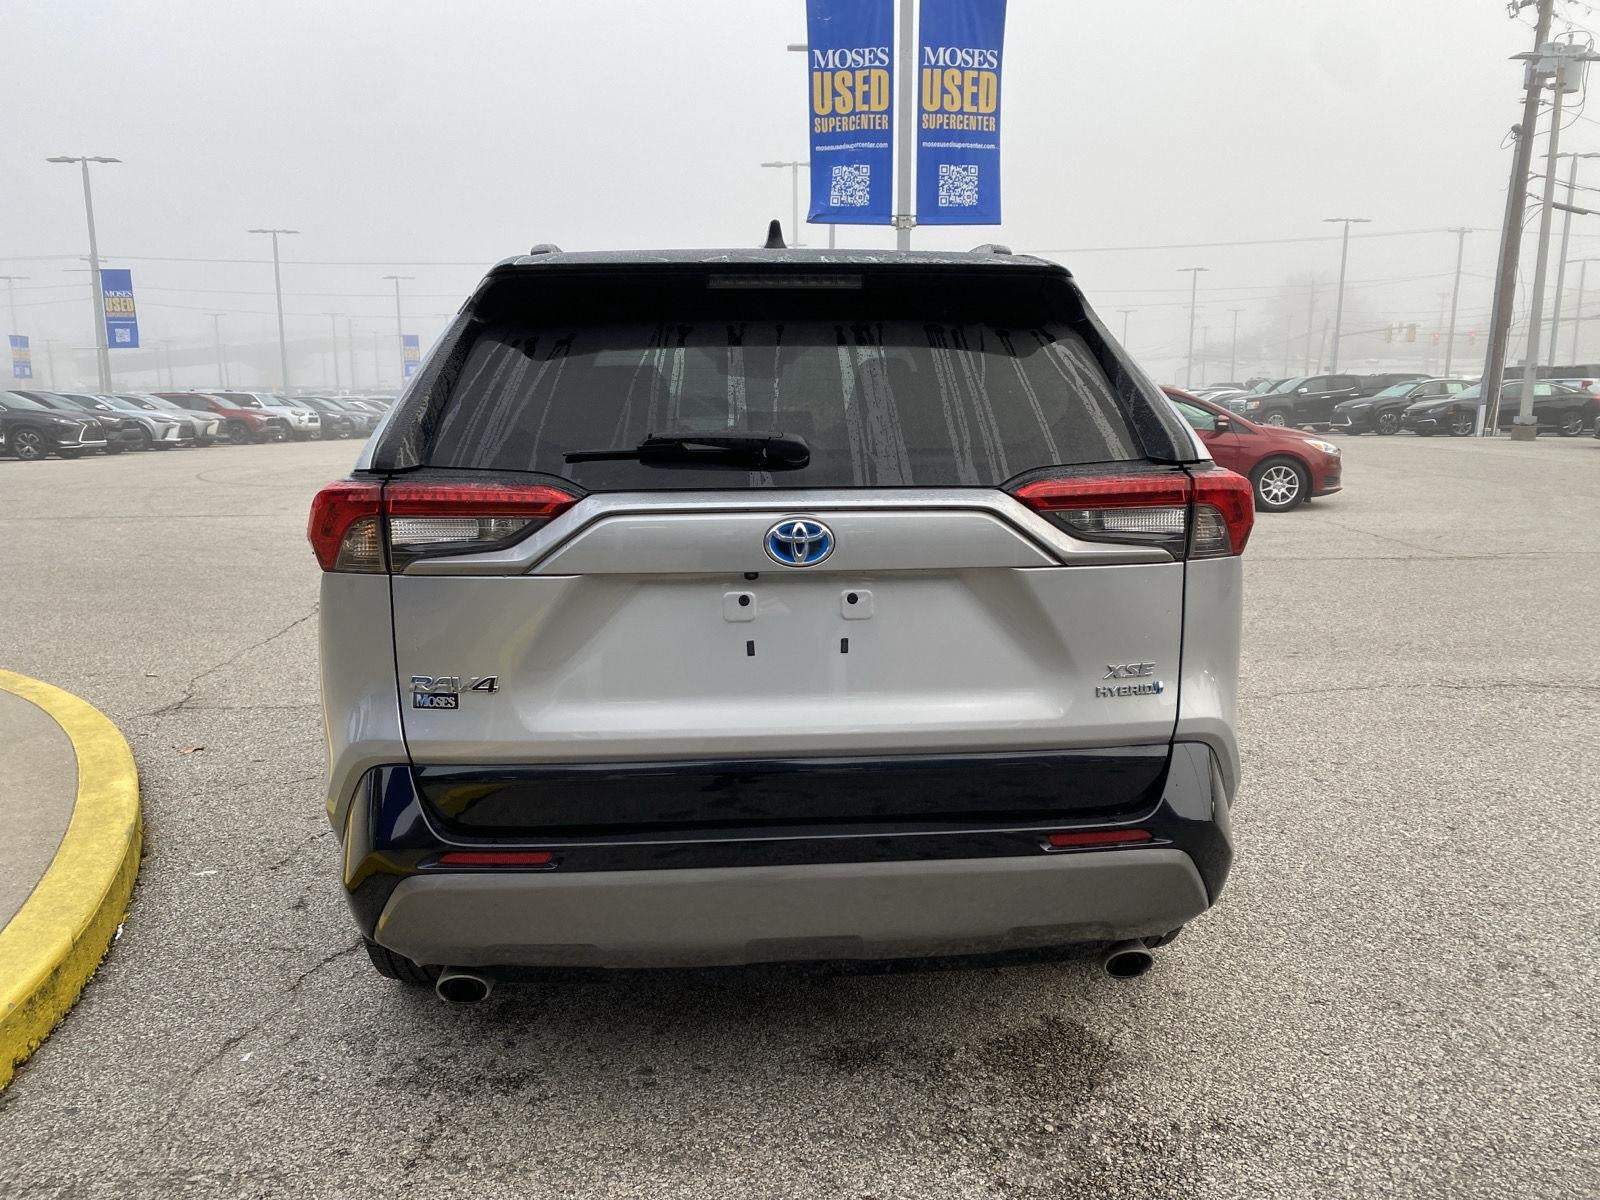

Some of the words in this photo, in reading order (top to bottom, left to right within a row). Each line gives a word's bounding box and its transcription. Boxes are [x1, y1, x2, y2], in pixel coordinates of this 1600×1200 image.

[812, 47, 889, 69] MOSES
[923, 47, 998, 68] MOSES
[812, 69, 889, 115] USED
[922, 68, 997, 113] USED
[814, 114, 889, 133] SUPERCENTER
[922, 113, 996, 131] SUPERCENTER
[815, 141, 889, 151] mosesusedsupercenter.com
[922, 141, 996, 149] mosesusedsupercenter.com
[104, 297, 134, 312] USED
[1103, 661, 1156, 680] XSE
[409, 675, 499, 693] RAV4
[1095, 683, 1155, 698] HYBRID
